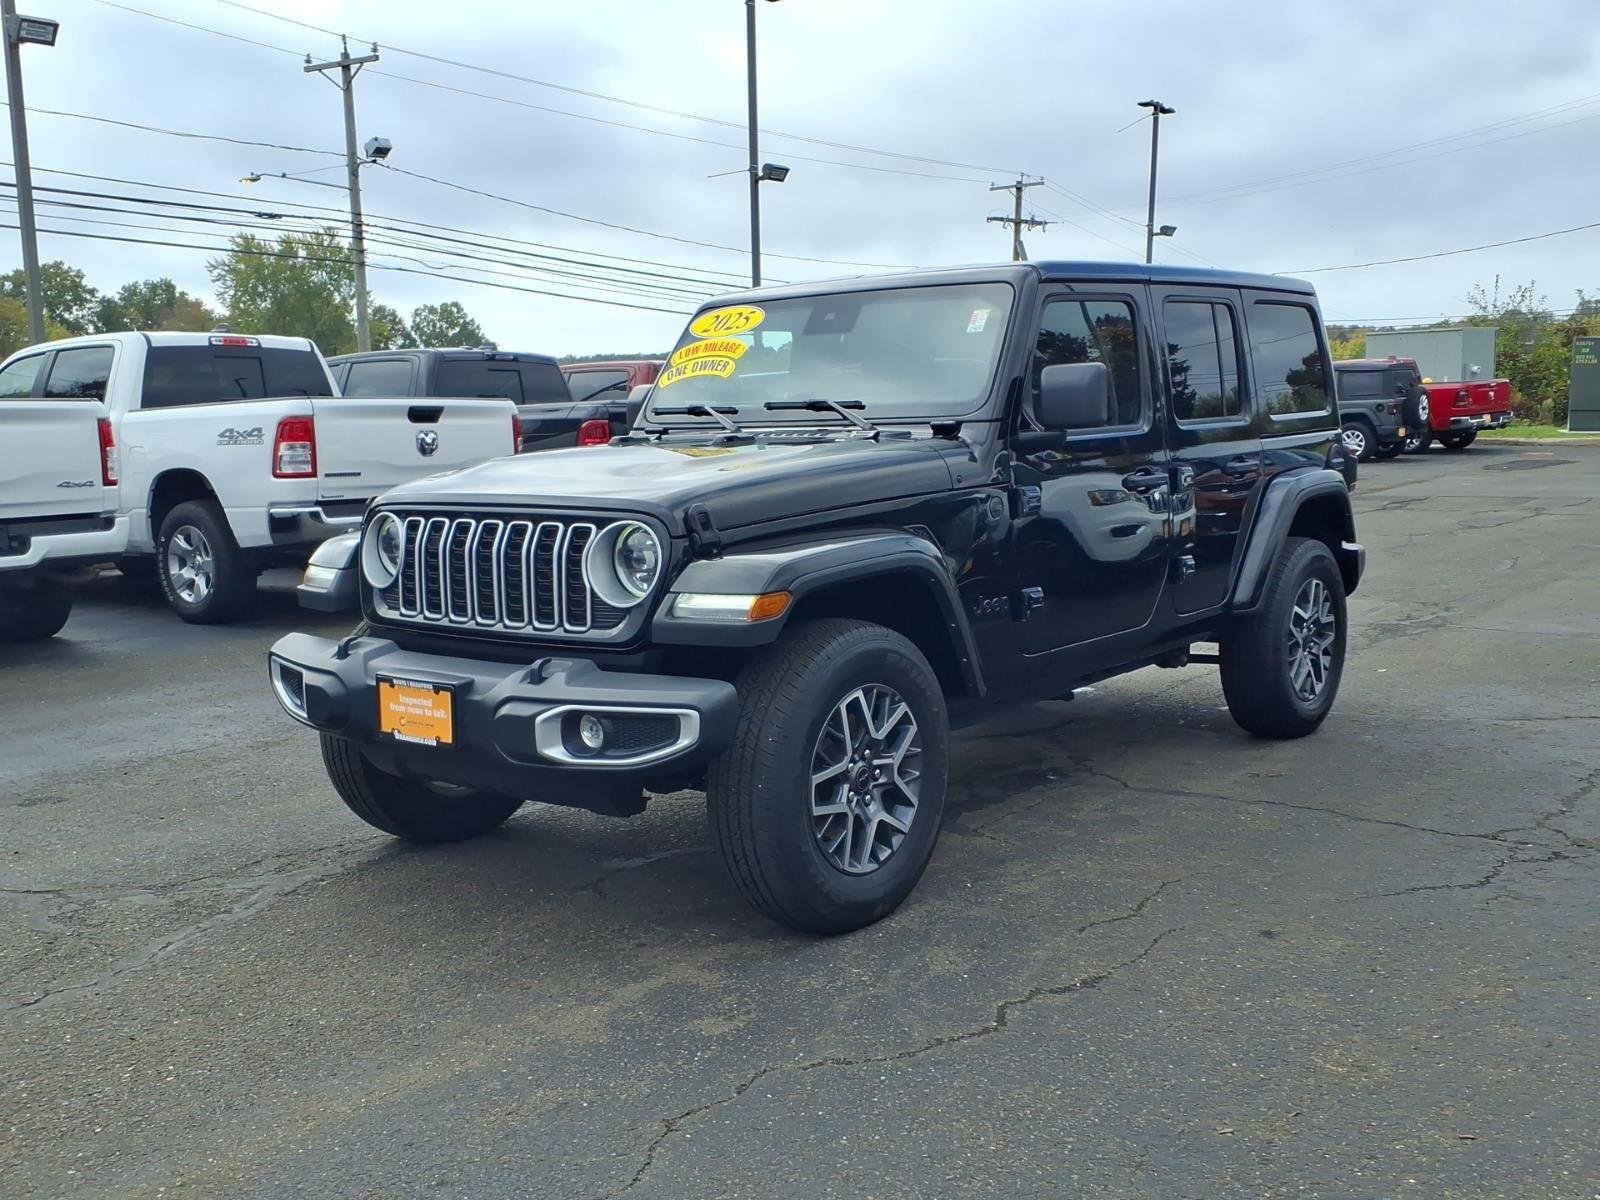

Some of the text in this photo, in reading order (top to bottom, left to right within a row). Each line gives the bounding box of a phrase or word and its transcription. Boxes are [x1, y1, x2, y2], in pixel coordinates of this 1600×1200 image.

[702, 311, 757, 333] 2025
[679, 342, 741, 359] LOW MILEAGE
[667, 360, 730, 381] ONE OWNER
[972, 595, 1009, 615] Jeep
[399, 694, 433, 708] Inspected
